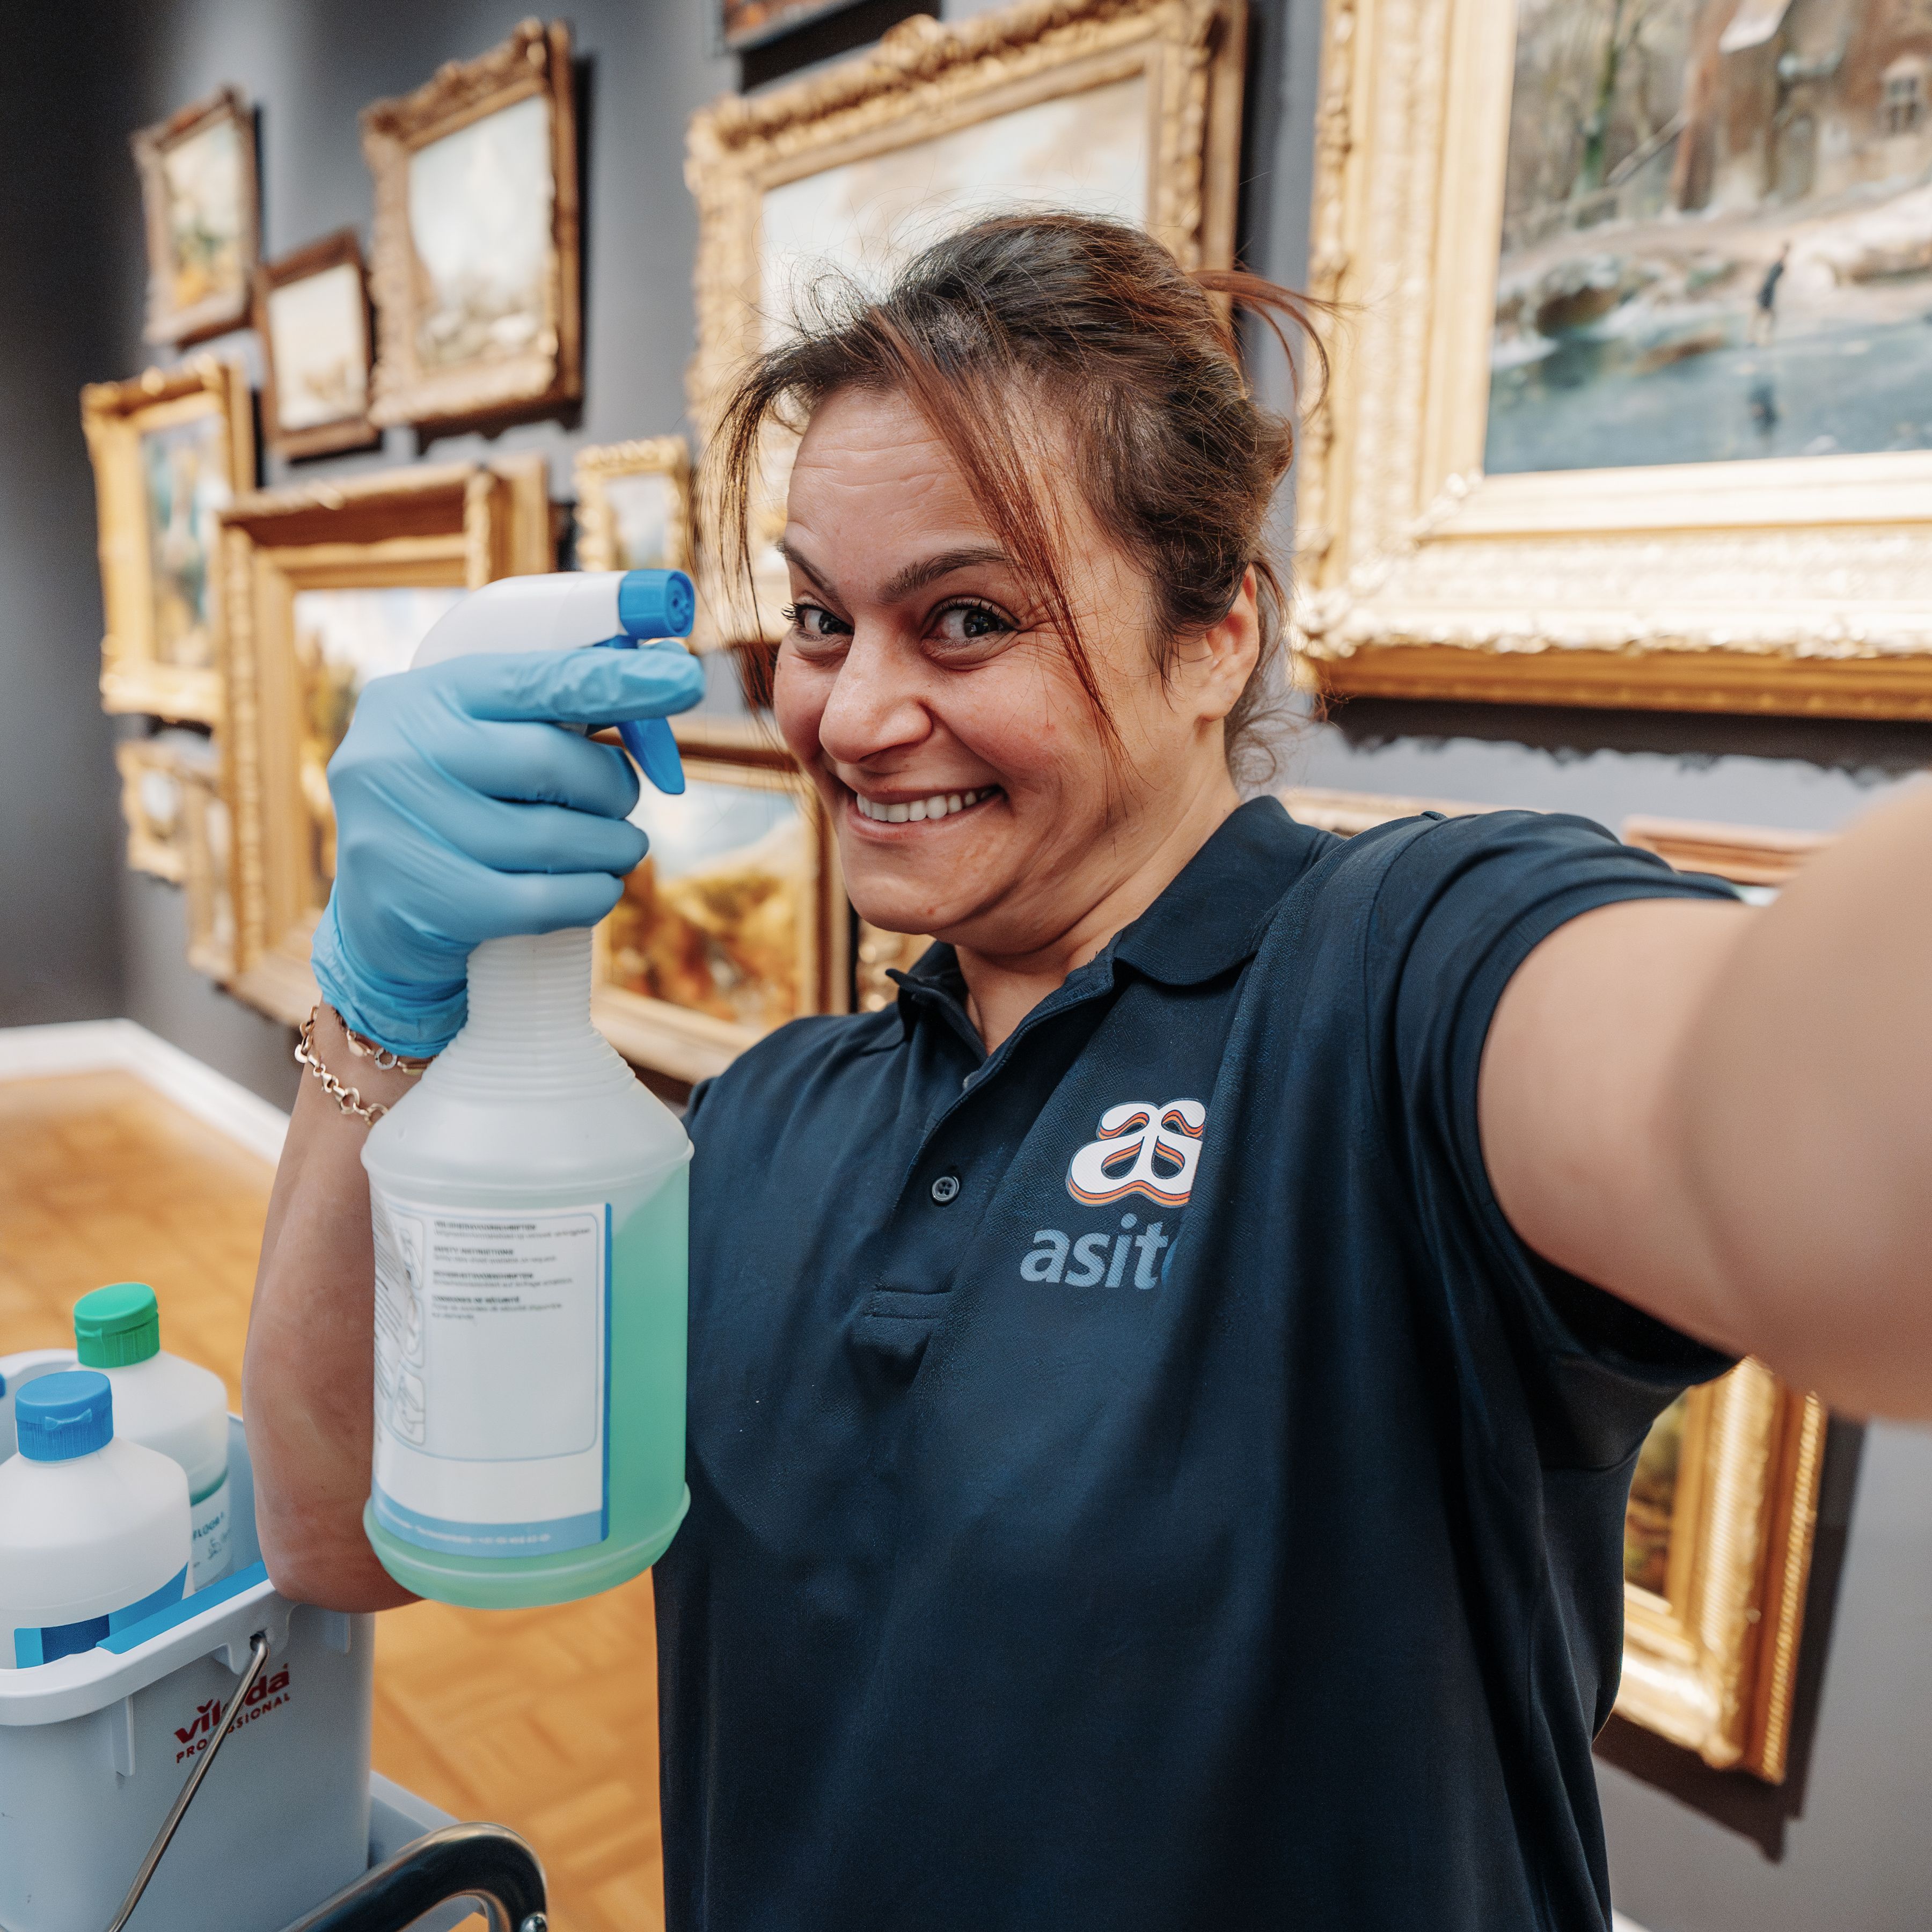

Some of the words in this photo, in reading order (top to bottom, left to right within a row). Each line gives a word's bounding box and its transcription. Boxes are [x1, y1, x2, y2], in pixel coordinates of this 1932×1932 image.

[1020, 1213, 1180, 1290] asit
[174, 1670, 290, 1744] vilda
[175, 1693, 290, 1764] PROSIONAL
